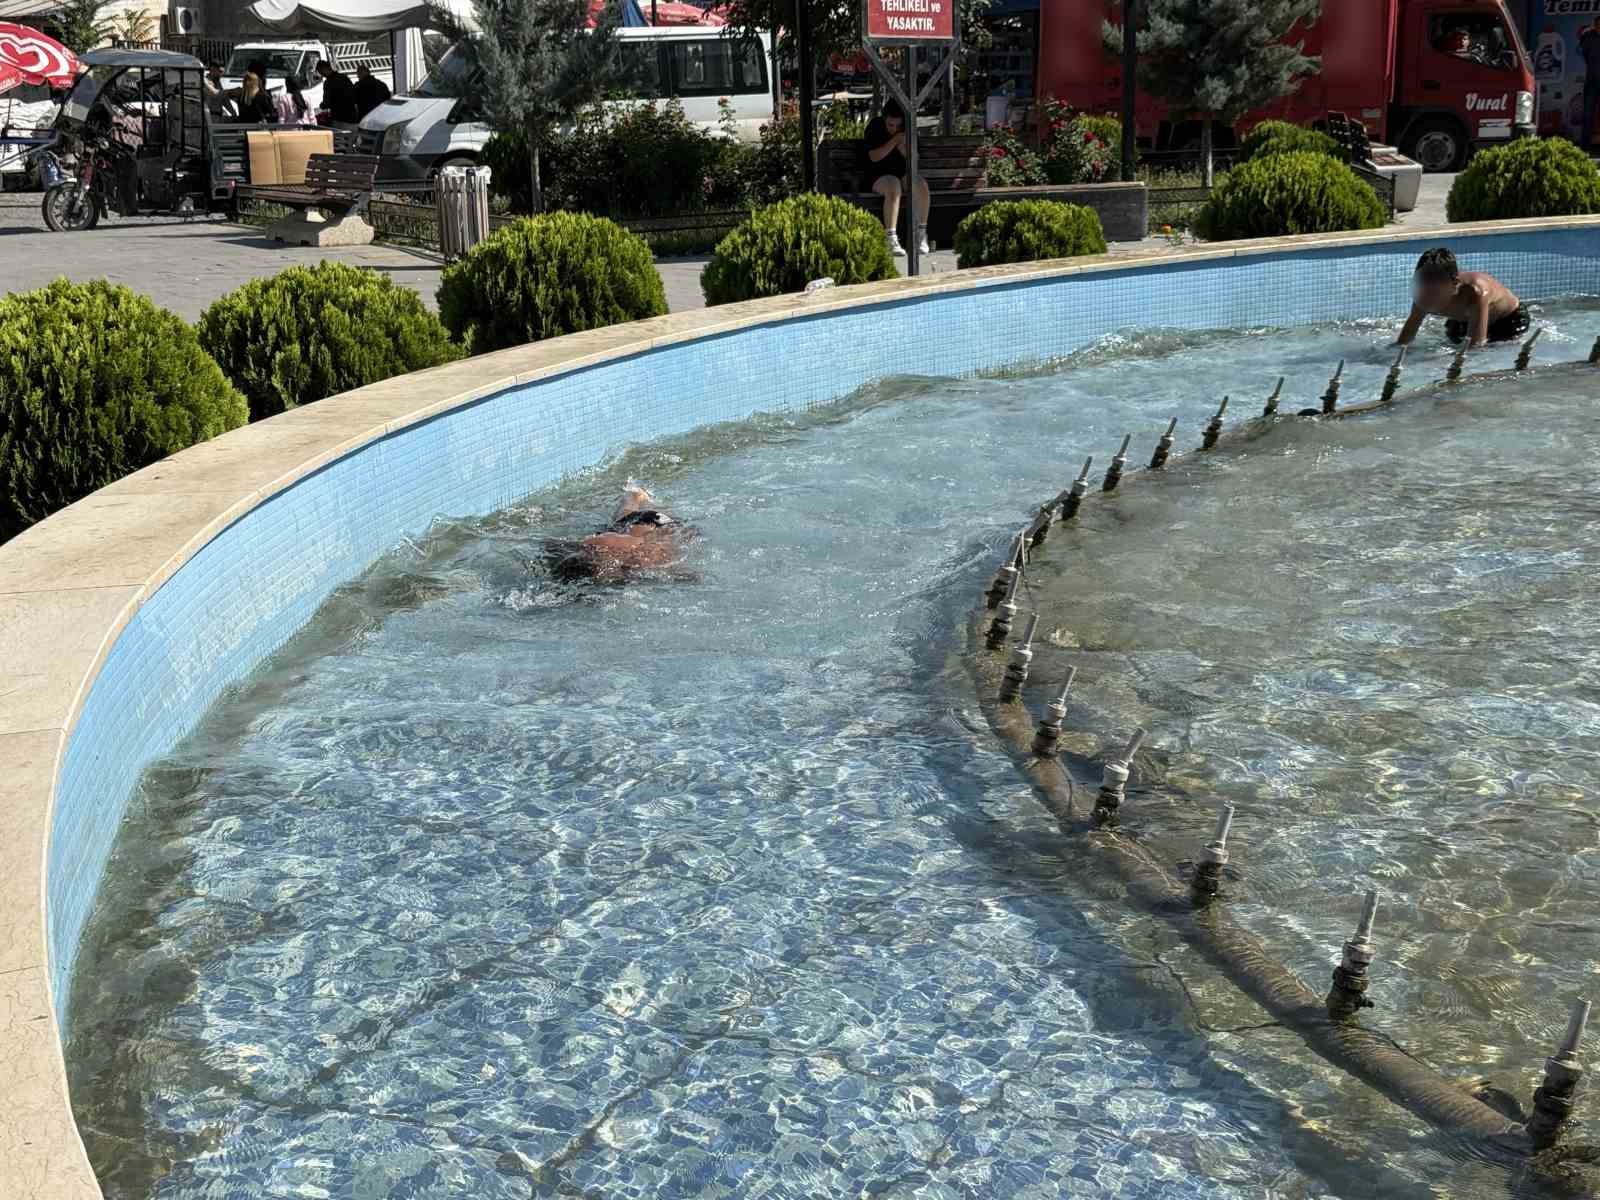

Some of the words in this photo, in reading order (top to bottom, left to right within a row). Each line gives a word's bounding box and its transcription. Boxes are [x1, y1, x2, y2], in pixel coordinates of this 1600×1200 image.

[931, 2, 941, 13] ve
[887, 16, 935, 31] YASAKTIR.
[1466, 92, 1508, 111] Vural
